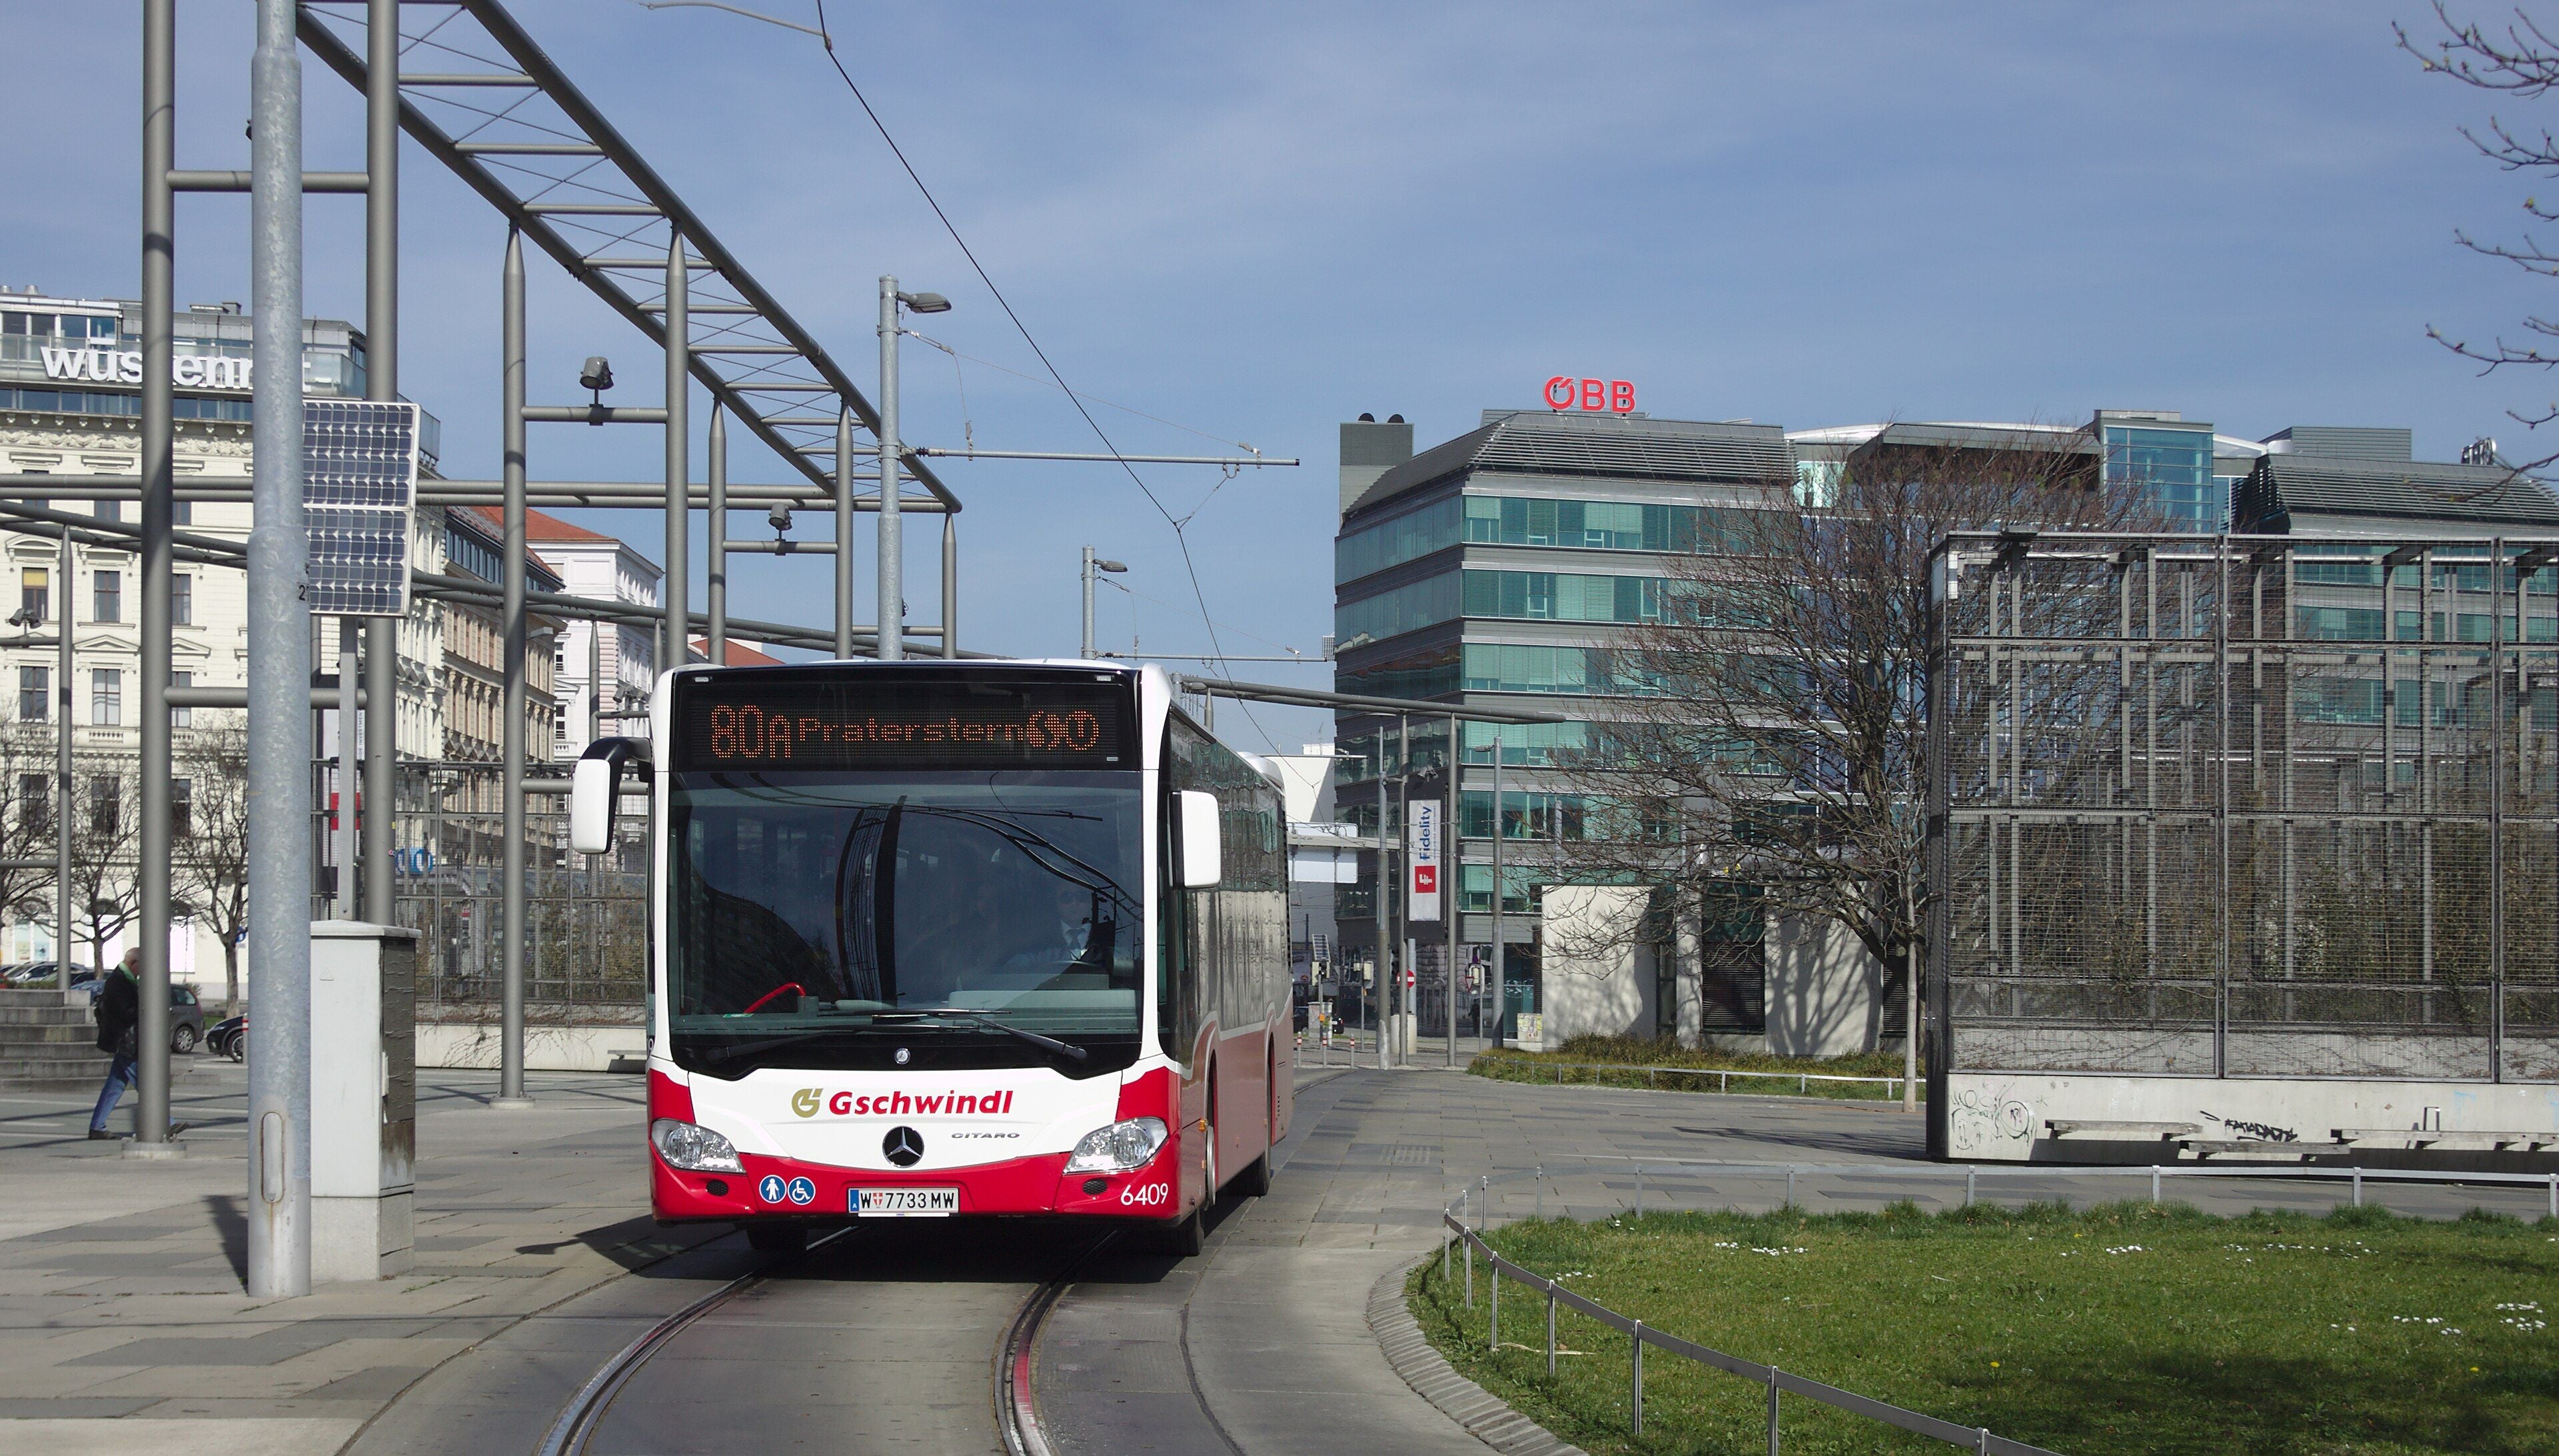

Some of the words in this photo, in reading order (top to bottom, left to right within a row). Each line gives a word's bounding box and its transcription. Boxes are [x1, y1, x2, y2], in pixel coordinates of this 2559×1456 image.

[711, 704, 791, 758] 80A
[799, 716, 1024, 742] Praterstern
[1419, 806, 1431, 860] Fidelity
[829, 1090, 1014, 1115] Gschwindl
[886, 1192, 926, 1208] 7733
[931, 1193, 954, 1208] MW
[1120, 1183, 1169, 1205] 6409
